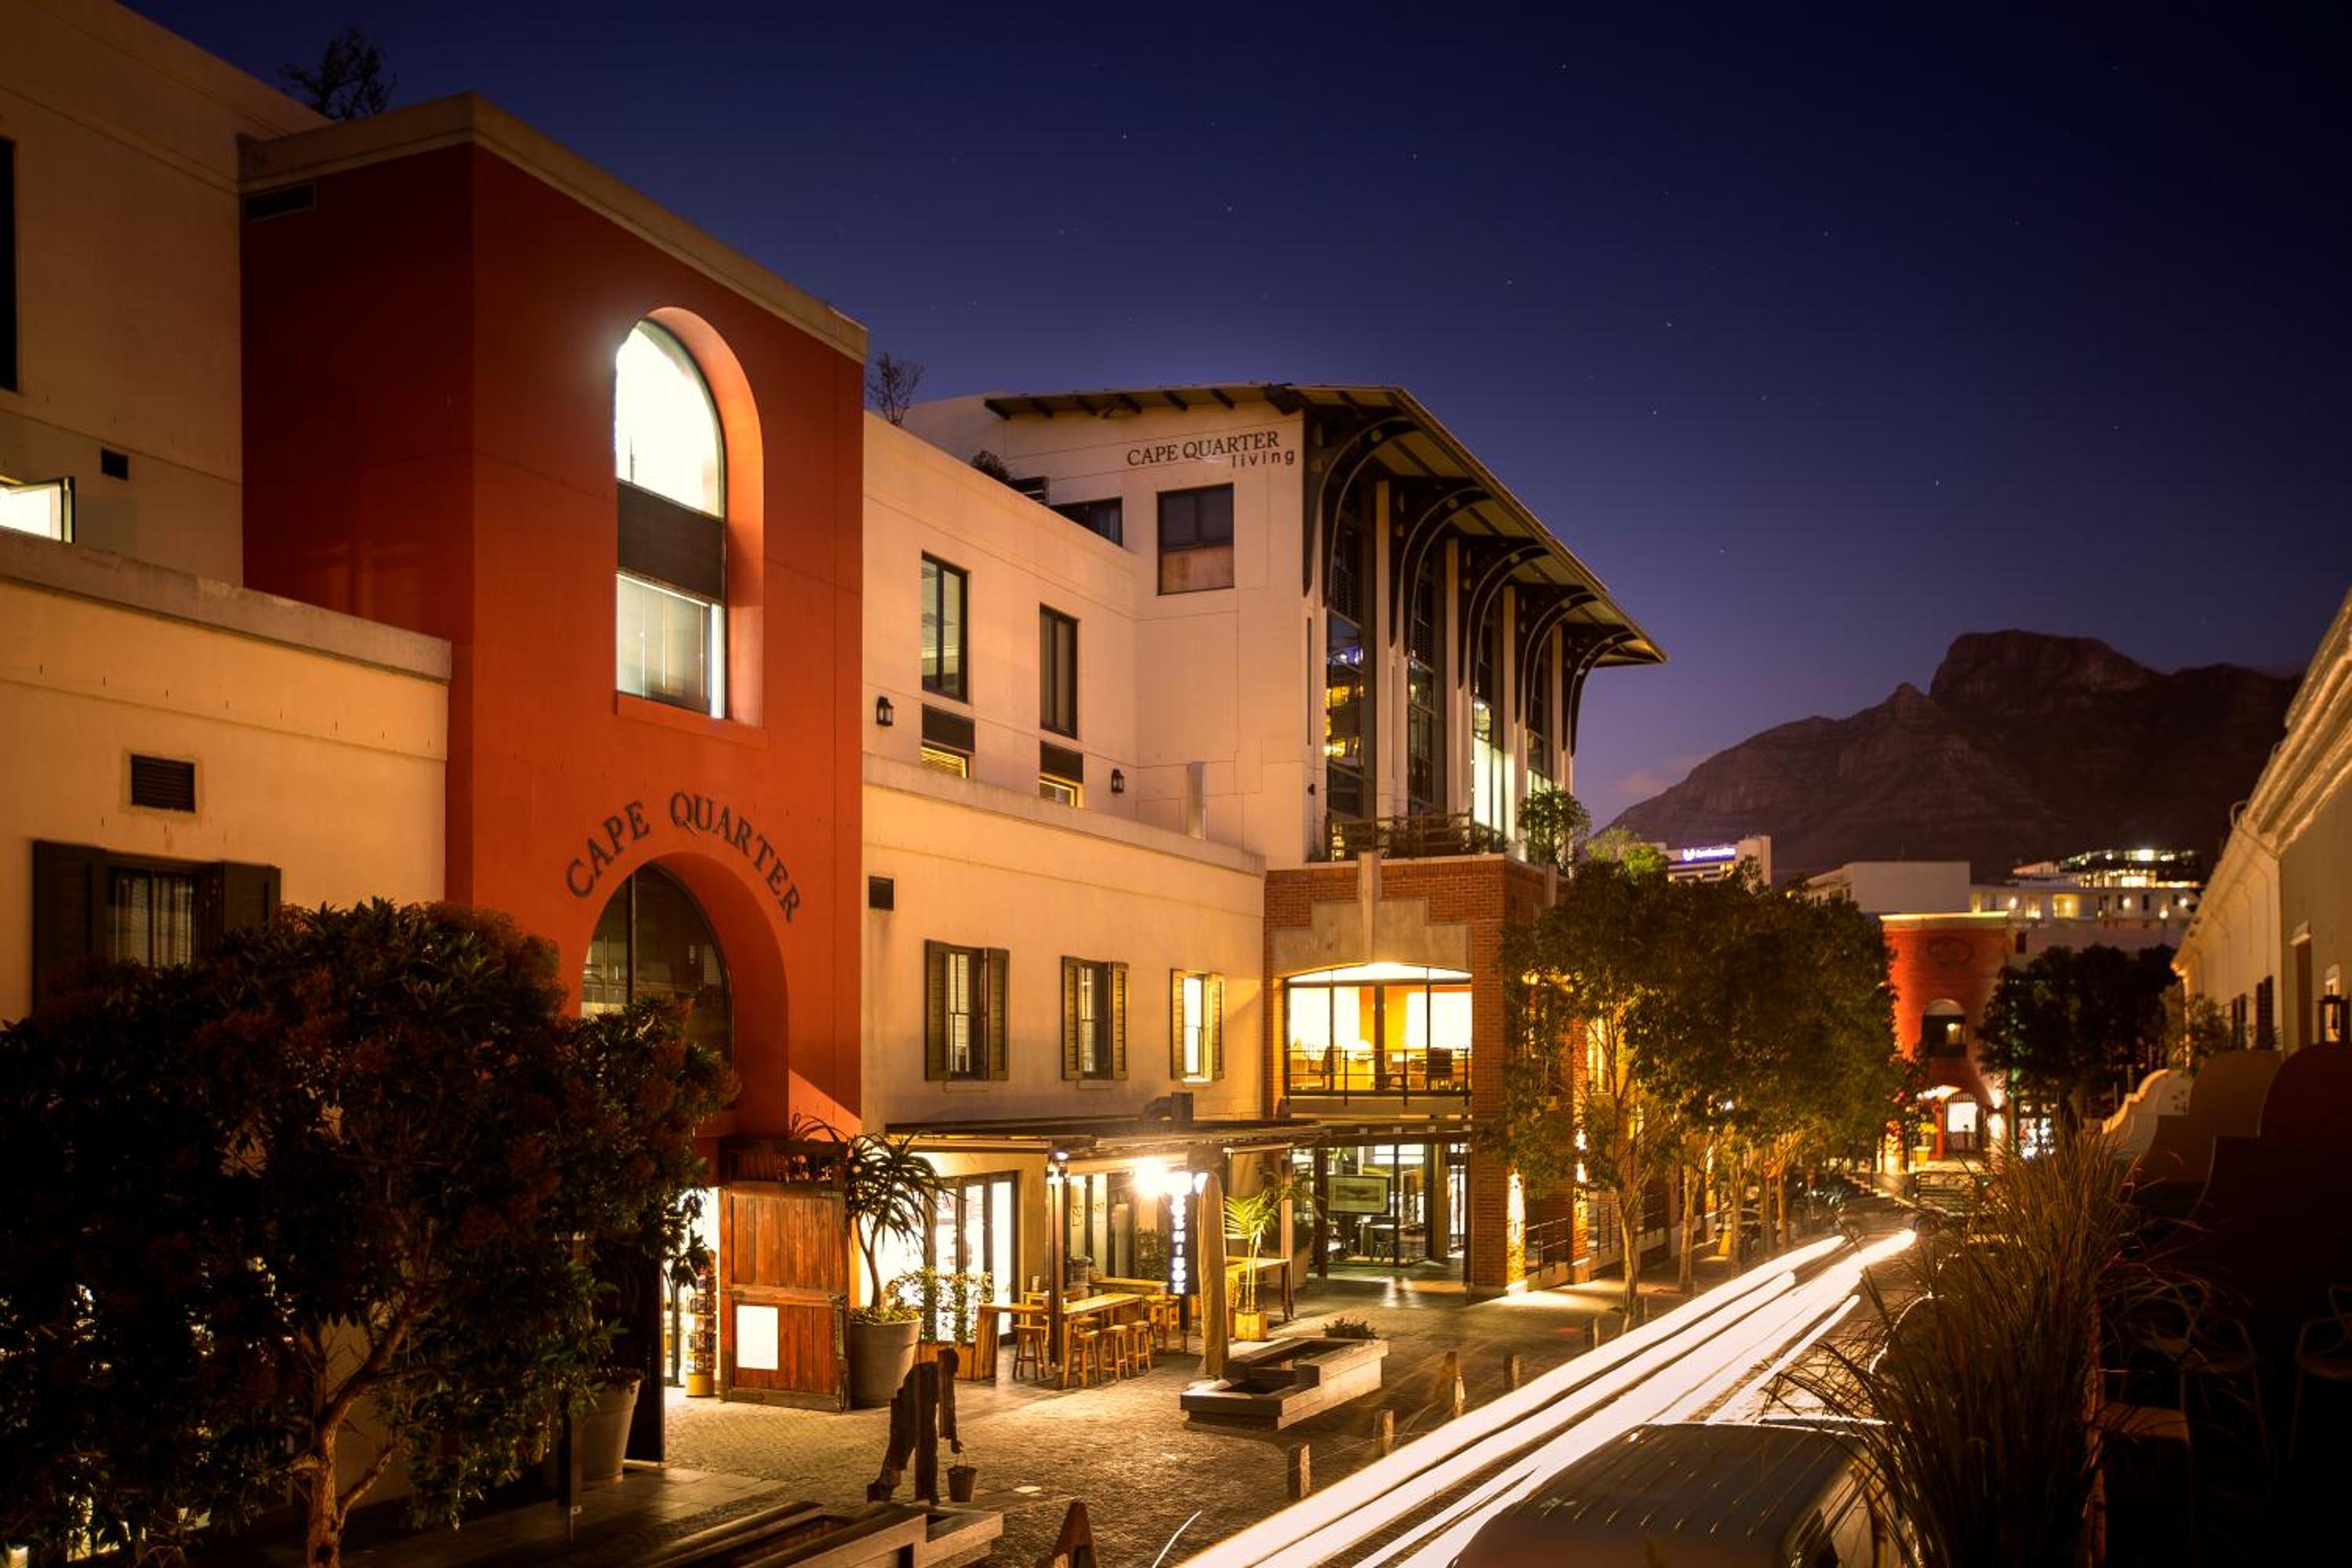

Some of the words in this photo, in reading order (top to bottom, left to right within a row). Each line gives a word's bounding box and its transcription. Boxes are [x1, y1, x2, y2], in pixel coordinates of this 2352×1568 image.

[1127, 444, 1178, 466] CAPE
[1182, 430, 1279, 459] QUARTER
[1232, 450, 1295, 469] living
[565, 800, 651, 898] CAPE
[669, 789, 802, 924] QUARTER
